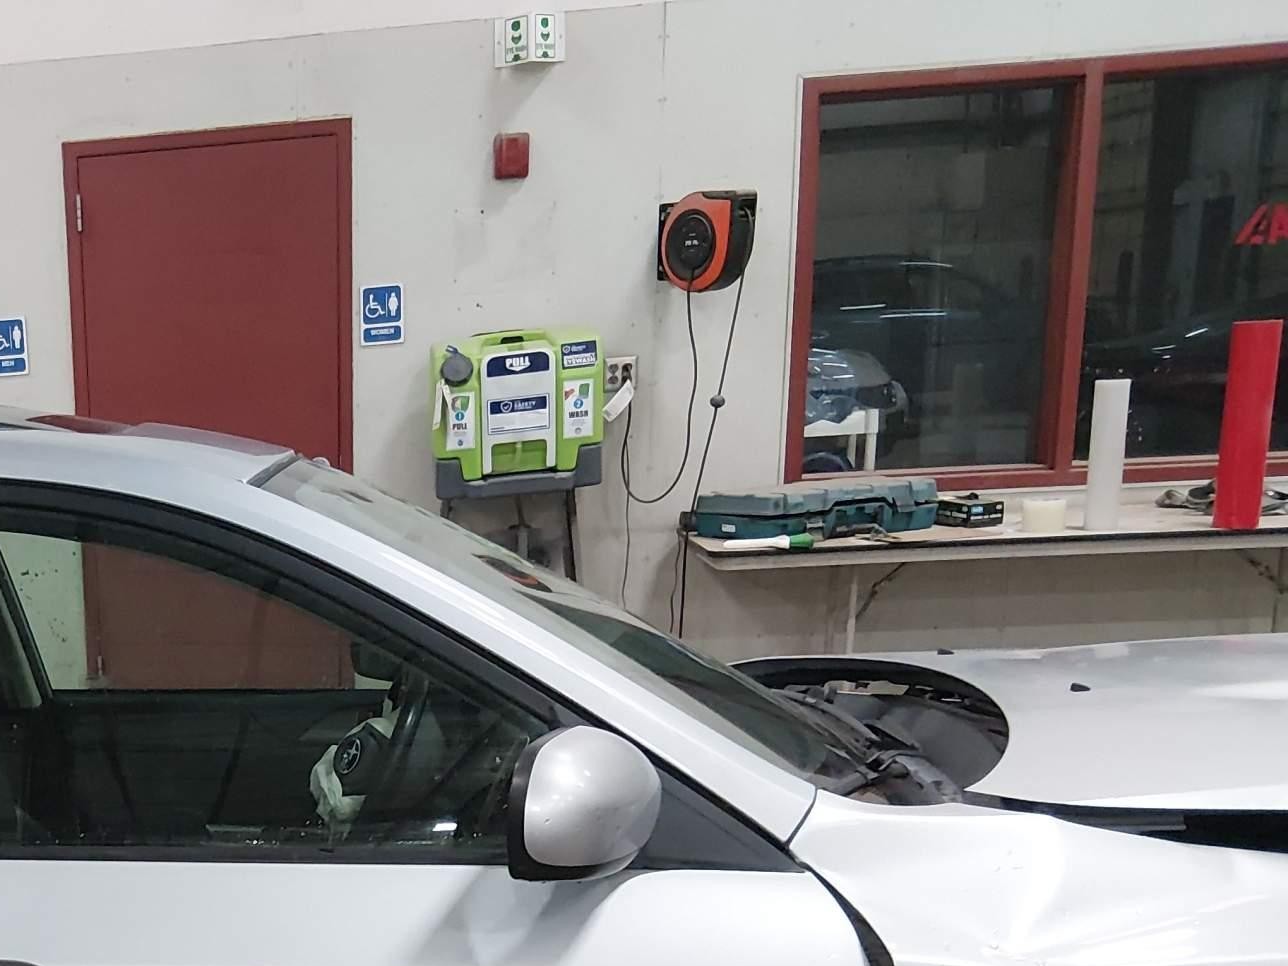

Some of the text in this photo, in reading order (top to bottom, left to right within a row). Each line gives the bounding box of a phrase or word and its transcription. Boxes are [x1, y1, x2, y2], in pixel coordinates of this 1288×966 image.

[370, 327, 394, 336] WOMEN
[505, 356, 530, 368] PULL
[568, 410, 589, 419] WASH
[452, 422, 467, 430] PULL
